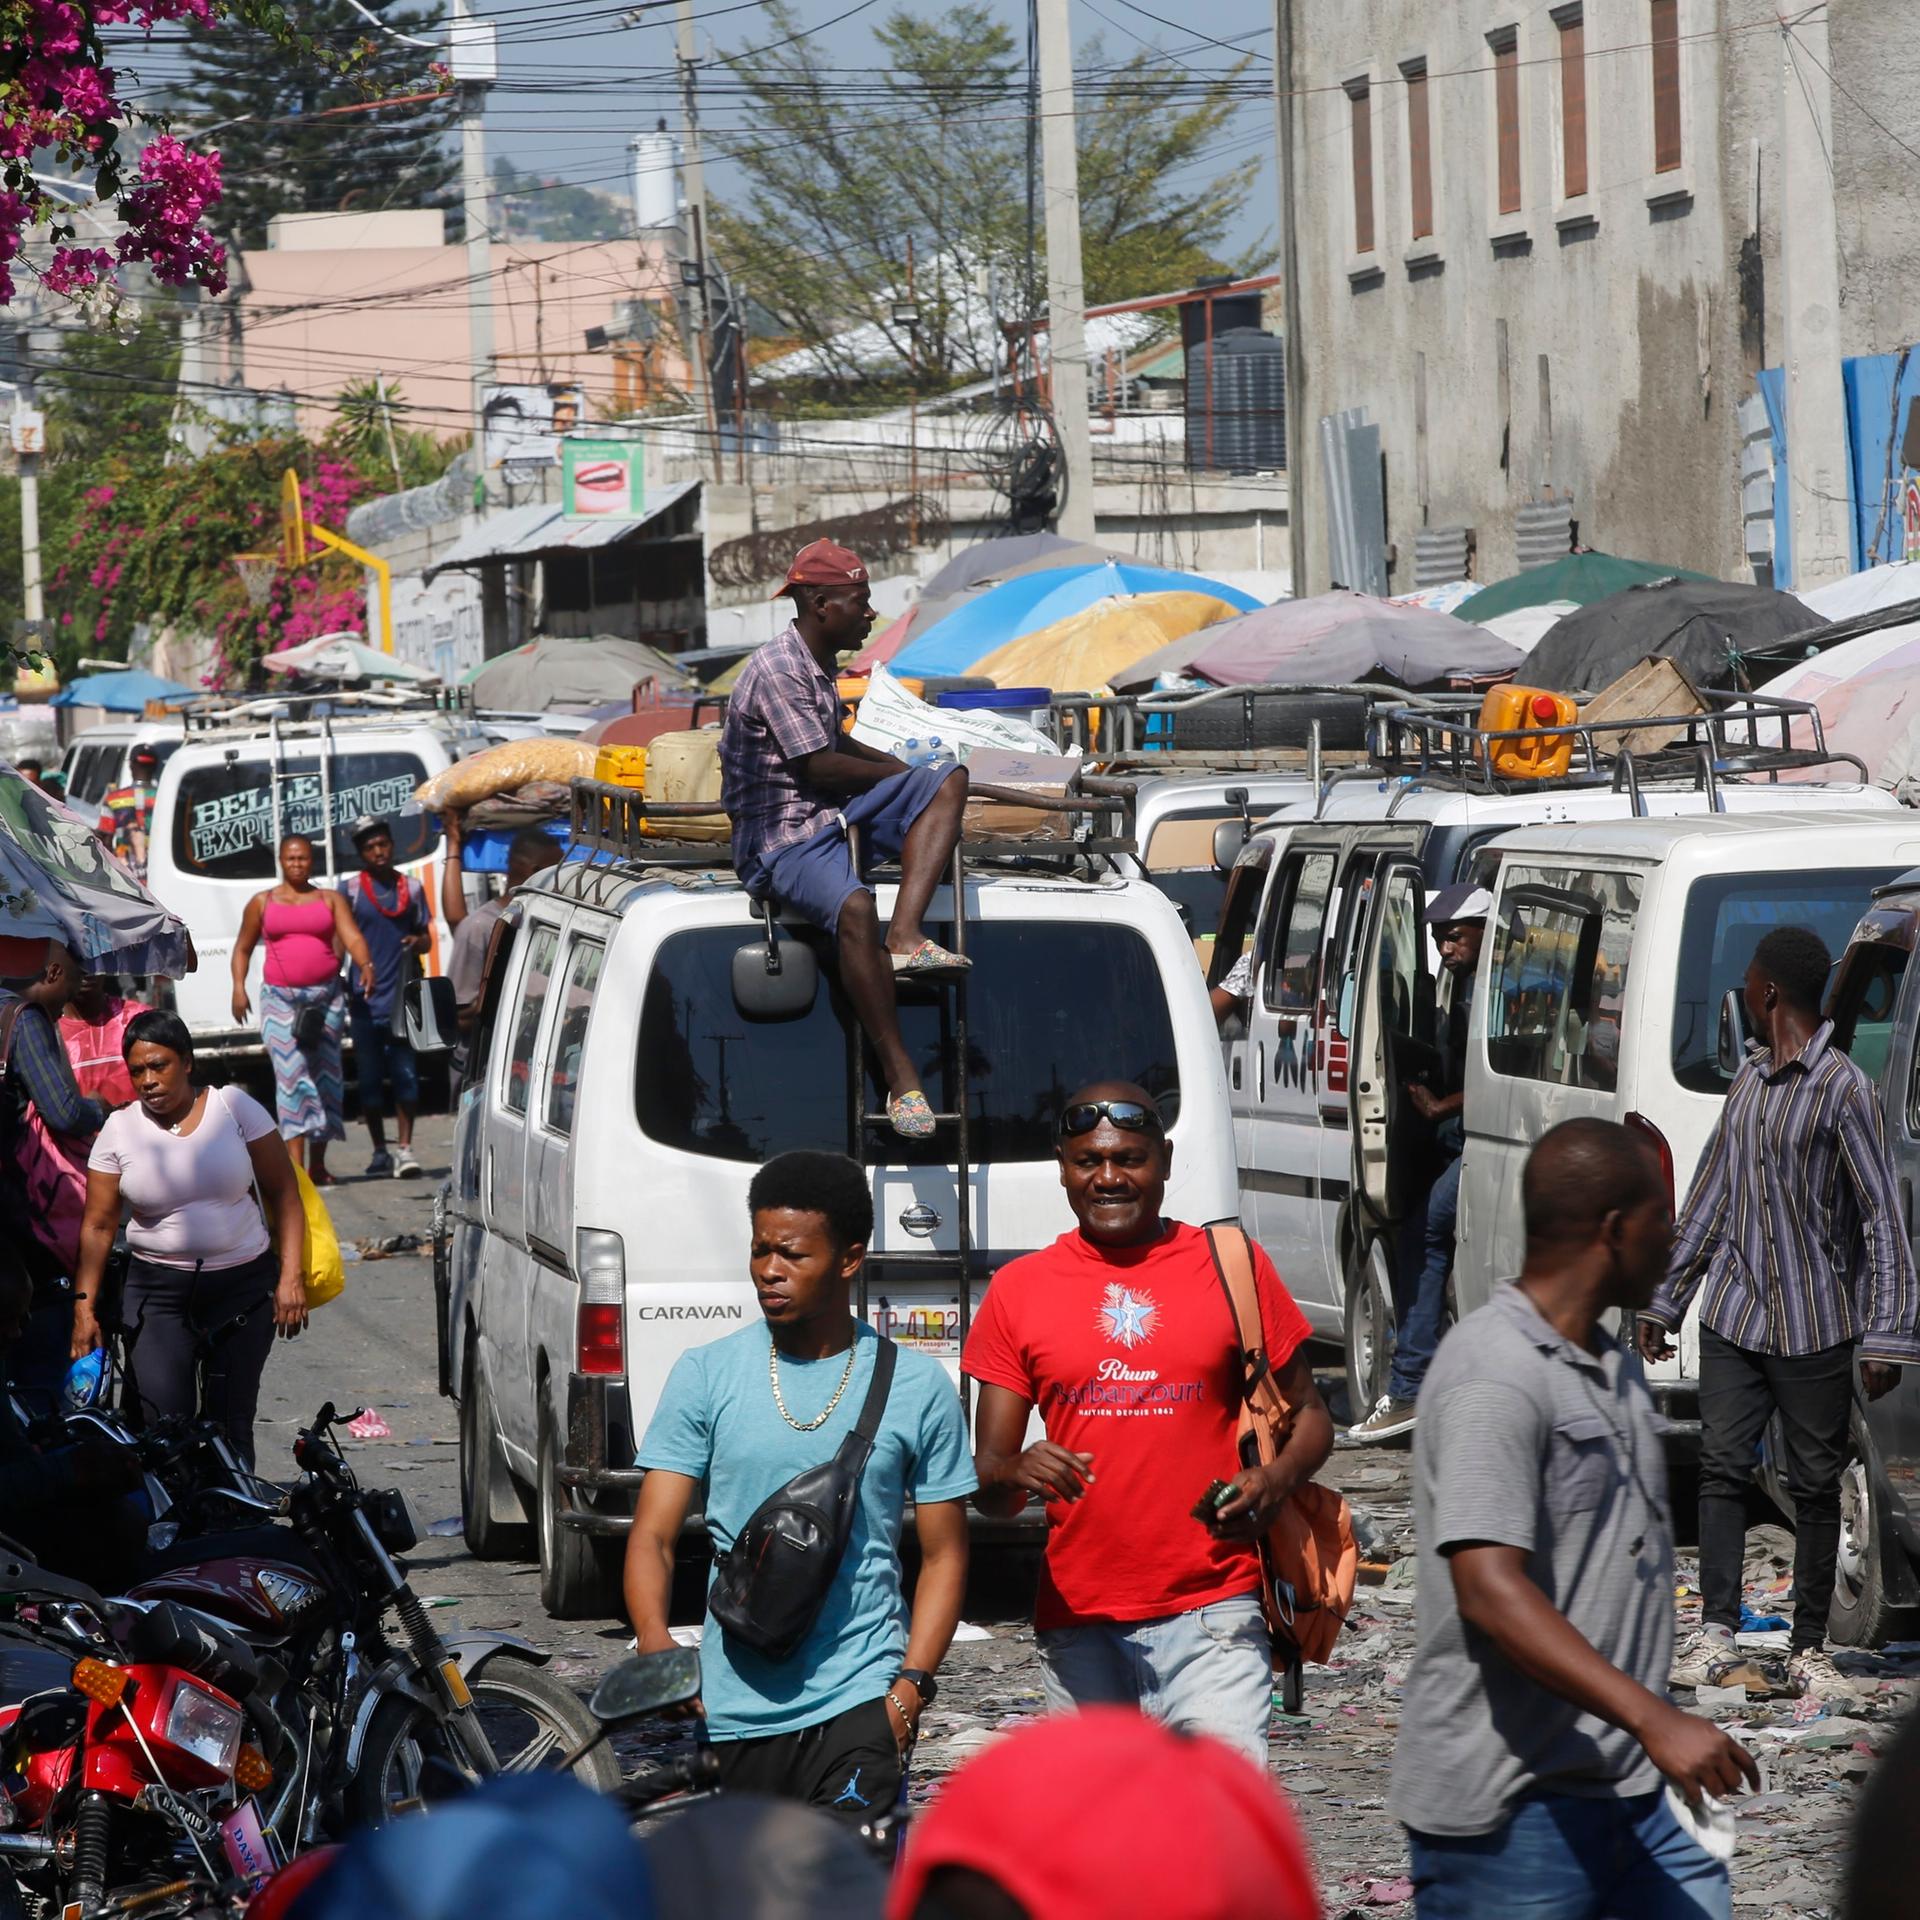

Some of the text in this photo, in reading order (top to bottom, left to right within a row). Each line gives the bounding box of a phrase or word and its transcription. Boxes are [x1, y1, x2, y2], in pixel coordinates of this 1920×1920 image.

[193, 776, 321, 829] BELLE
[190, 774, 416, 862] EXPERIENCE
[638, 1305, 742, 1321] CARAVAN
[1096, 1358, 1159, 1382] Rhum
[1052, 1378, 1205, 1406] Barbancourt
[1078, 1408, 1112, 1417] HAITIEN
[1116, 1408, 1149, 1417] DEPUIS
